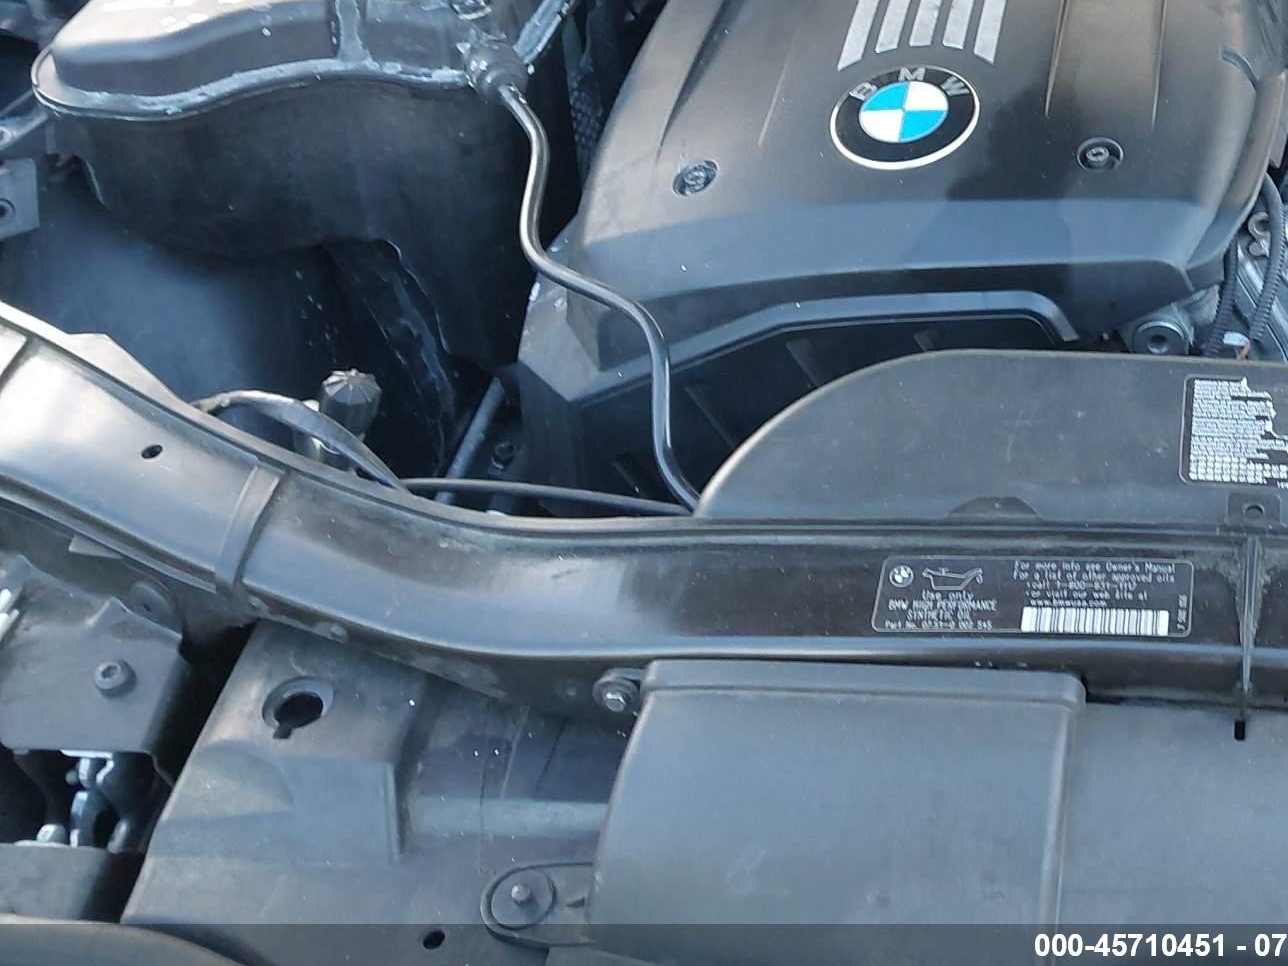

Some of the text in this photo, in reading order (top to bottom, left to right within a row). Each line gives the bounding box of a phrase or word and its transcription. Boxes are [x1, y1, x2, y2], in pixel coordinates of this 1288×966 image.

[848, 66, 970, 101] BMW
[1014, 560, 1176, 573] For more info see Owner's Manual
[1012, 570, 1029, 580] For
[1045, 569, 1061, 580] list
[1066, 571, 1077, 580] of
[1082, 570, 1106, 581] other
[1112, 572, 1152, 583] approved
[1156, 573, 1175, 583] oils
[1046, 589, 1067, 598] visit
[1072, 590, 1087, 599] our
[1092, 590, 1111, 600] web
[888, 598, 909, 611] BMW
